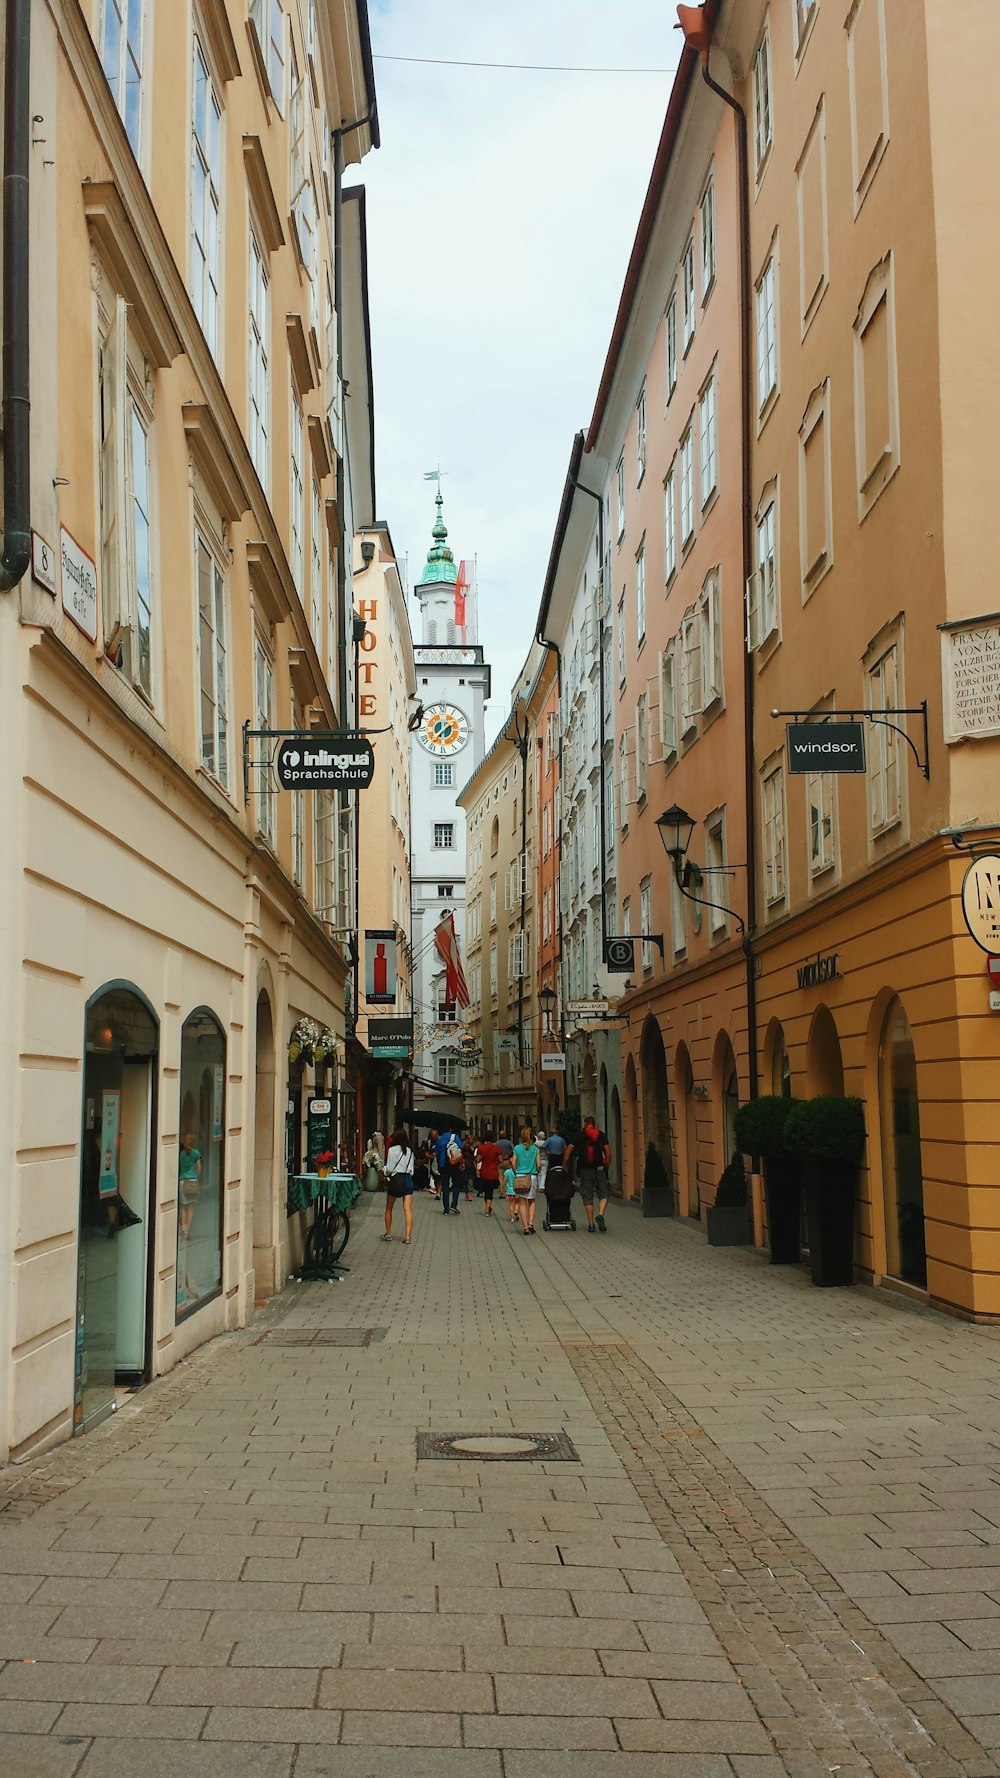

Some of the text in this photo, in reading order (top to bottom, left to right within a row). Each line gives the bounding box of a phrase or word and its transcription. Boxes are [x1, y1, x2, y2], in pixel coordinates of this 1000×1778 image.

[41, 545, 49, 571] 8
[953, 630, 992, 646] FRANZ
[958, 644, 981, 656] VON
[954, 667, 980, 678] MANN
[955, 673, 999, 688] FORSCHER
[956, 687, 978, 698] ZELL
[794, 742, 858, 753] windsor.
[303, 749, 370, 769] inlingua
[283, 769, 368, 780] Sprachschule
